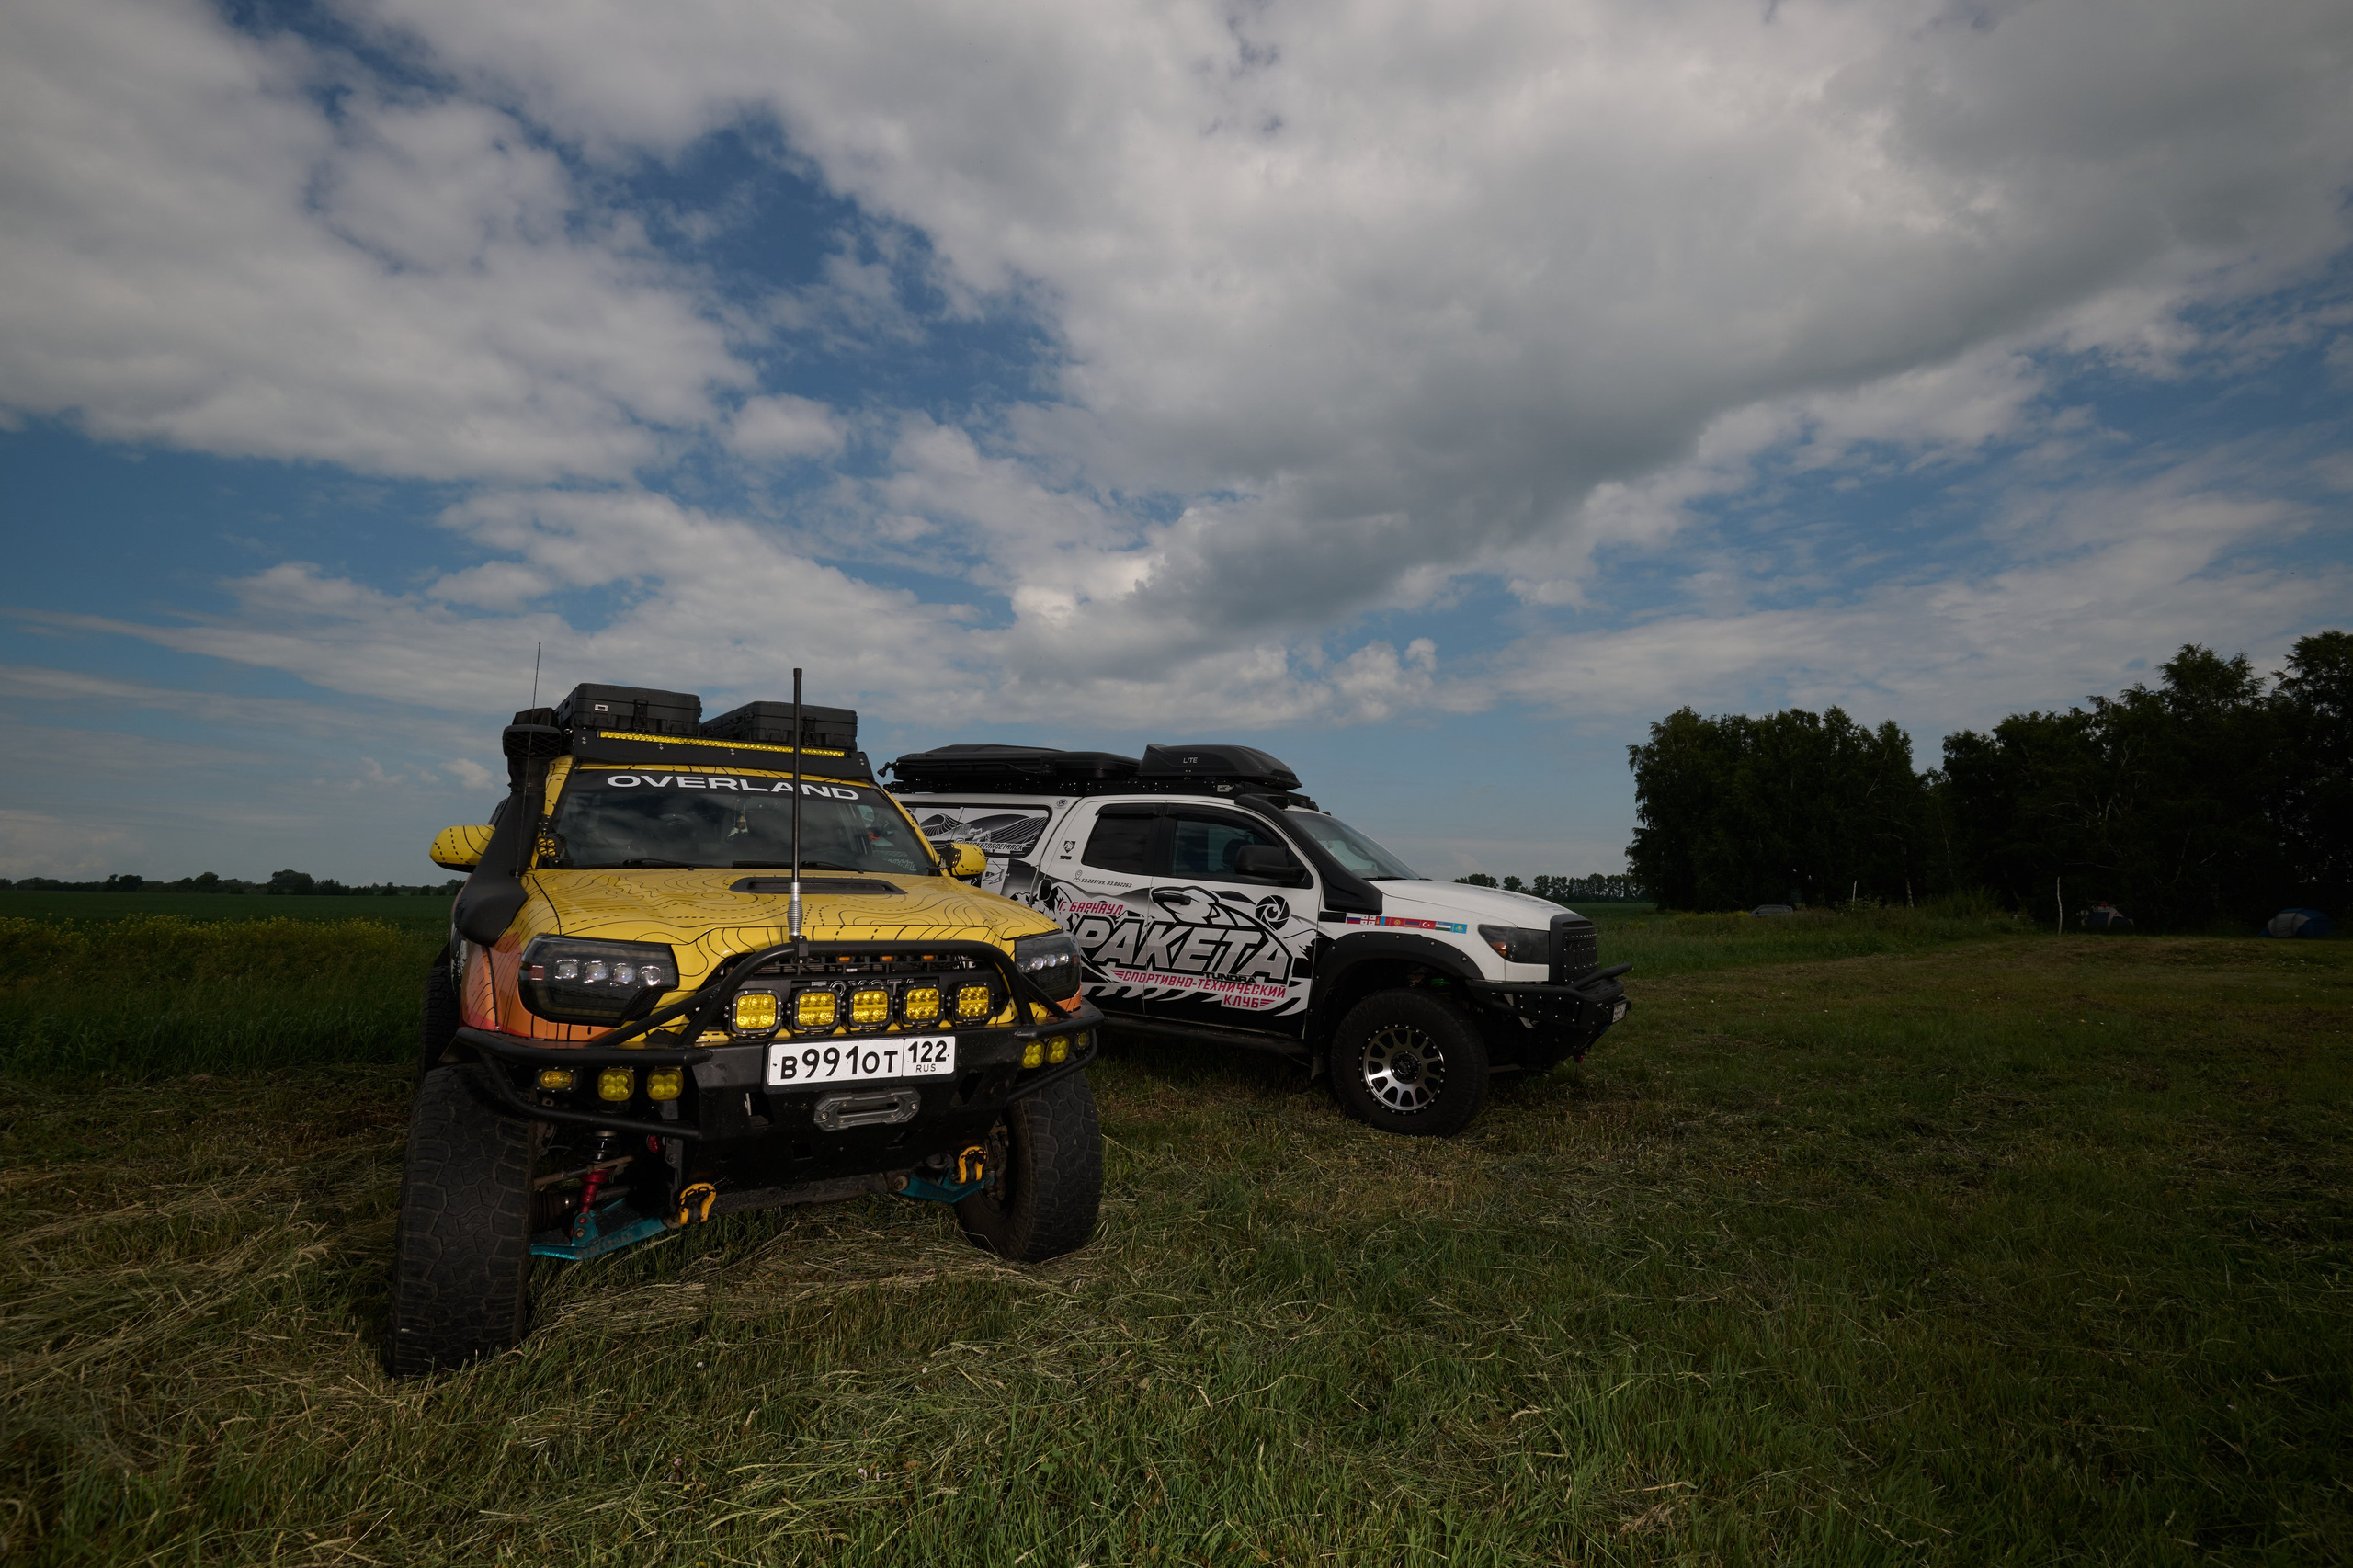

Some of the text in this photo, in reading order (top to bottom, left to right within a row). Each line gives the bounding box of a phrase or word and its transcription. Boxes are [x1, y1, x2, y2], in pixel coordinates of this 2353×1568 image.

[607, 775, 859, 801] OVERLAND
[1069, 902, 1124, 915] БАРНАУЛ
[1076, 917, 1290, 983] РАКЕТА
[1122, 971, 1287, 998] СПОРТИВНО-ТЕХНИЧЕСКИЙ
[1205, 972, 1257, 984] TUNDRA
[1223, 995, 1260, 1008] КЛУБ
[907, 1040, 948, 1063] 122
[915, 1062, 937, 1074] RUS
